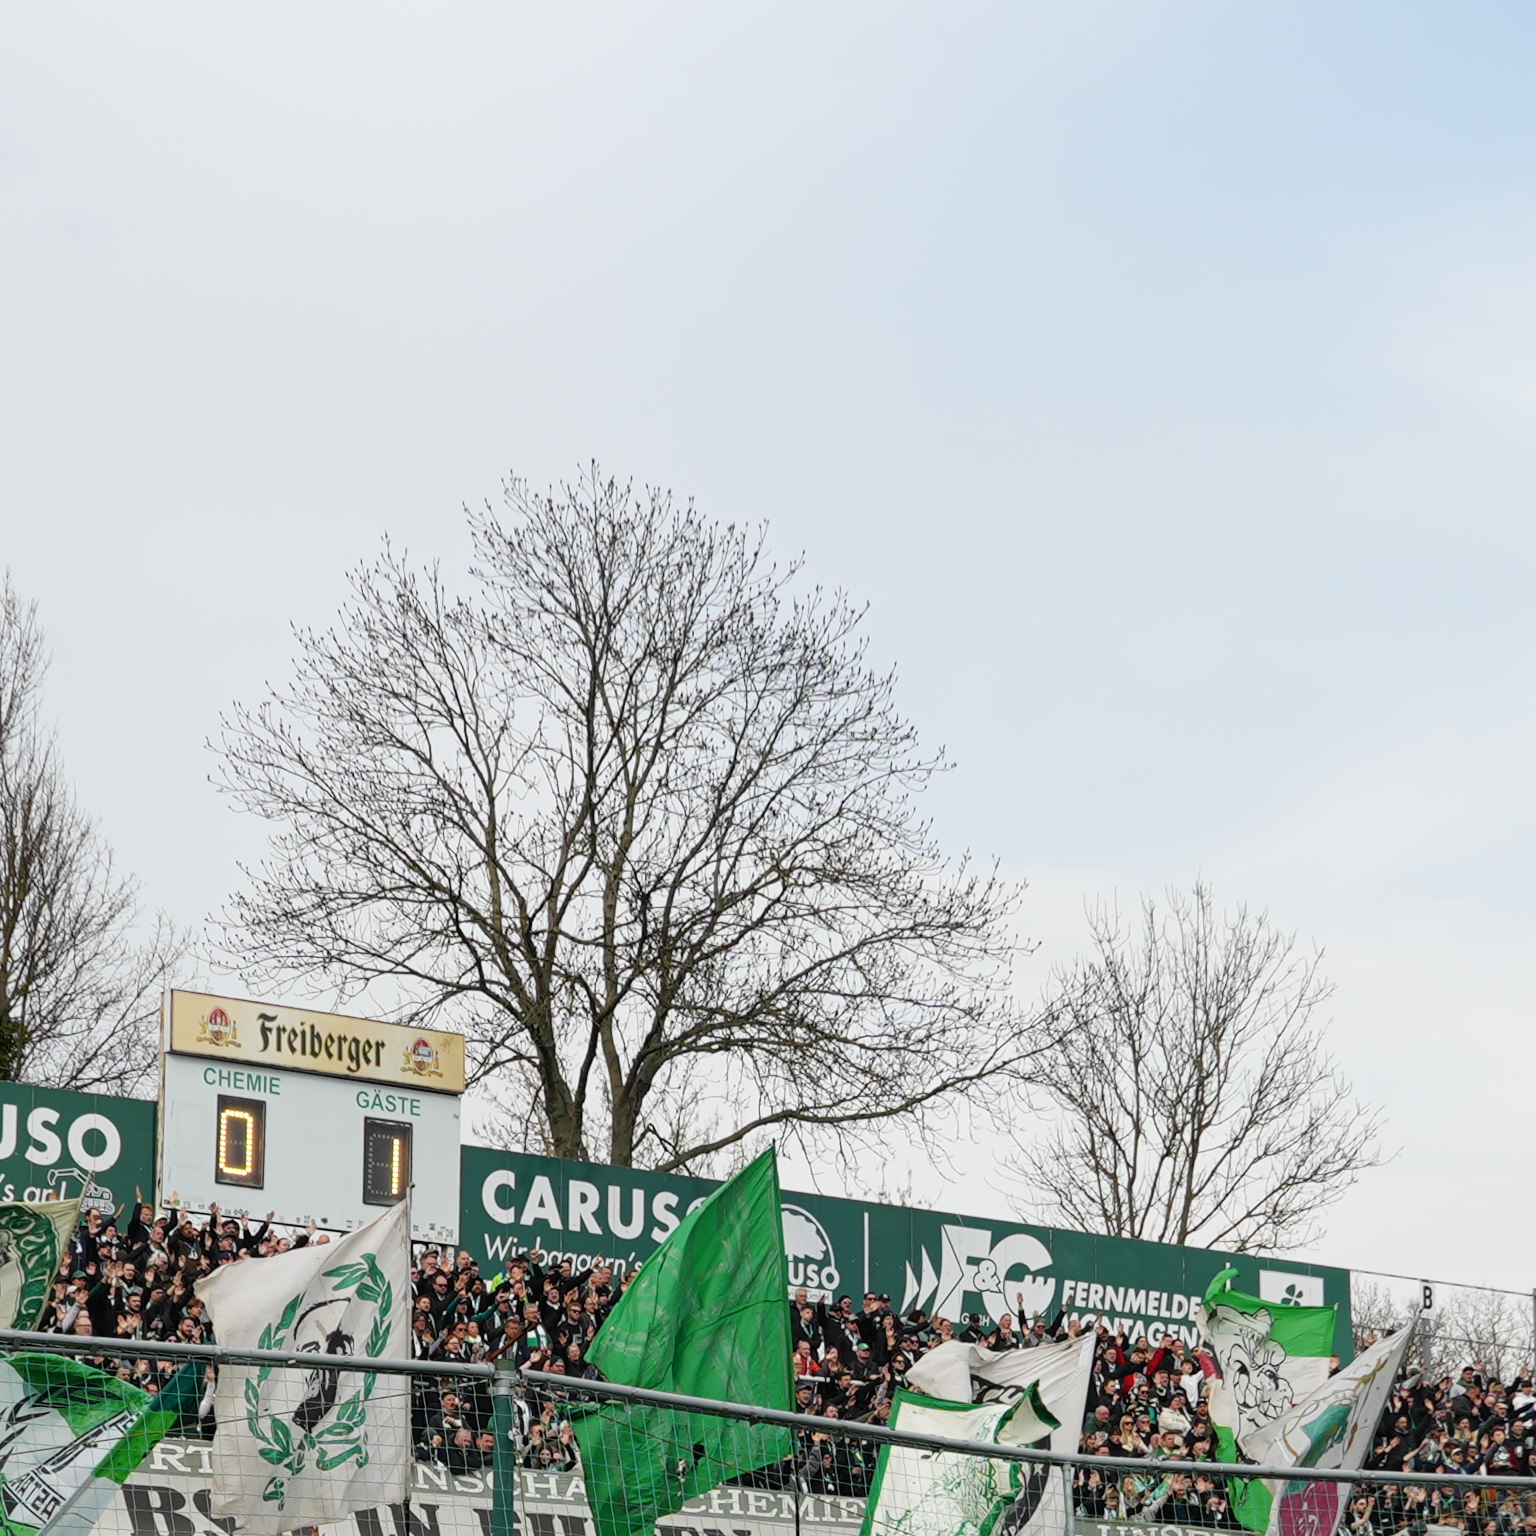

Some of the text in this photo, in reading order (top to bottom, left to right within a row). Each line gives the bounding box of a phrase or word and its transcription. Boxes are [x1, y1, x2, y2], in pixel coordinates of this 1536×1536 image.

[257, 1012, 386, 1073] Freiberger
[203, 1067, 281, 1096] CHEMIE
[356, 1088, 421, 1117] GÄSTE
[219, 1109, 253, 1176] 0
[481, 1169, 707, 1245] CARUS
[1061, 1280, 1202, 1321] FERNMELDE
[1422, 1285, 1433, 1310] B
